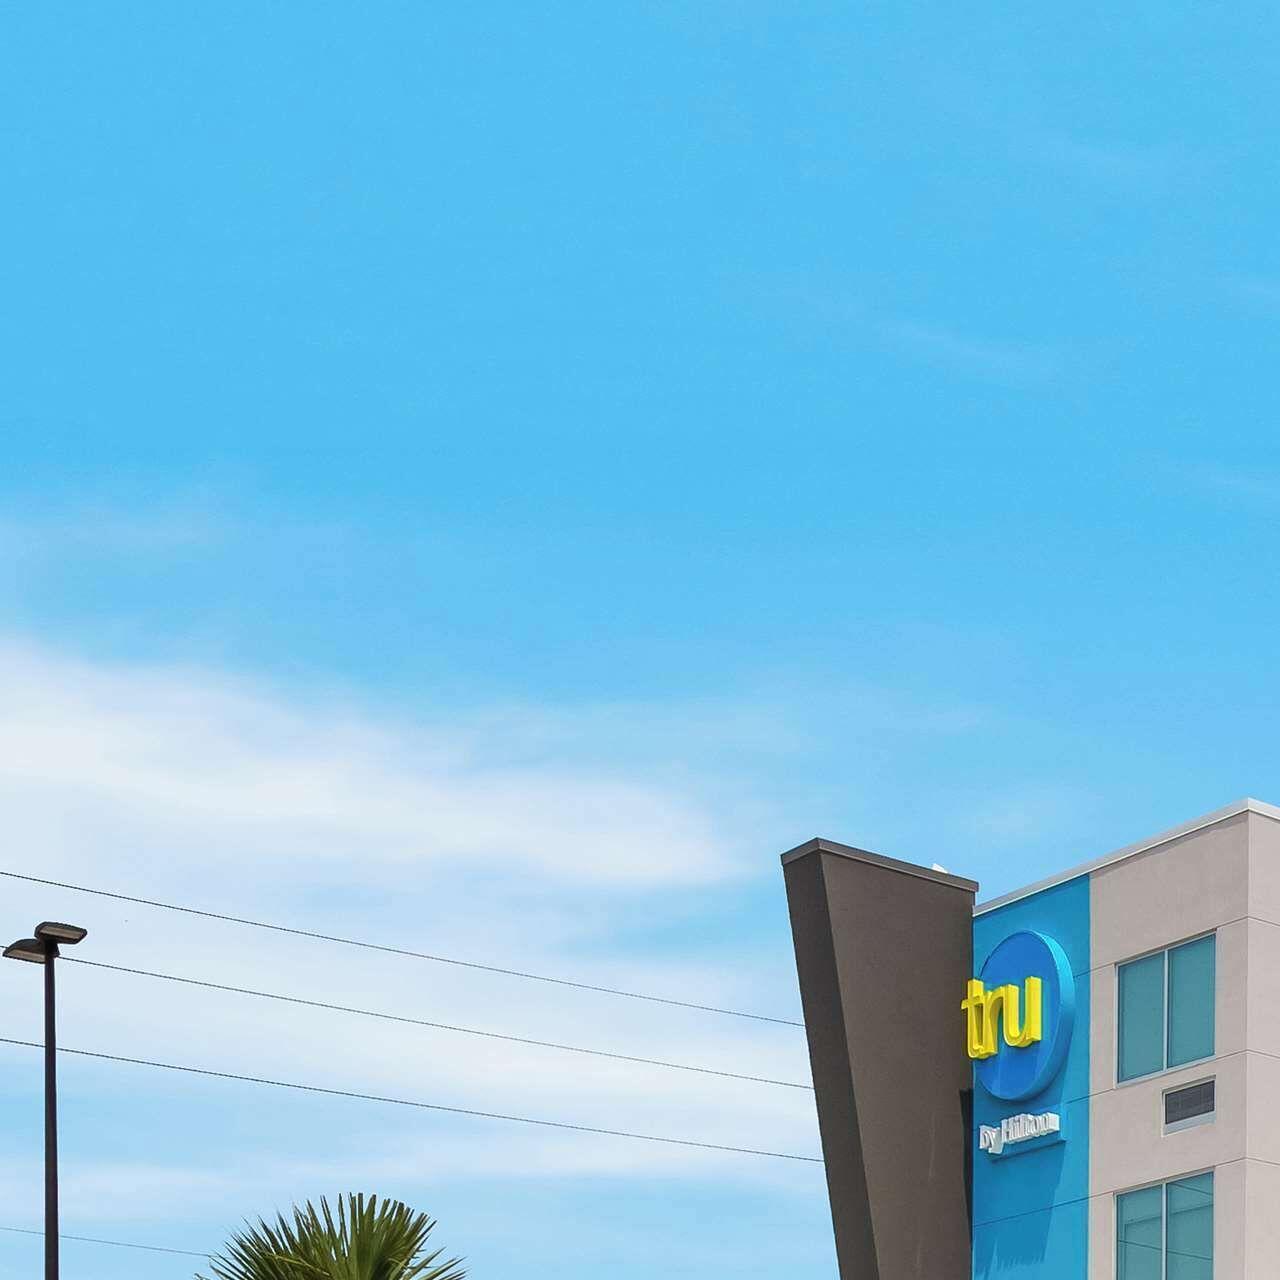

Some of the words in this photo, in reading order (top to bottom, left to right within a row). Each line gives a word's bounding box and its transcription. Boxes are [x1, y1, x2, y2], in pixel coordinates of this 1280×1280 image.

[961, 976, 1042, 1059] tru
[979, 1125, 1003, 1154] by
[1001, 1112, 1060, 1144] Hilton
